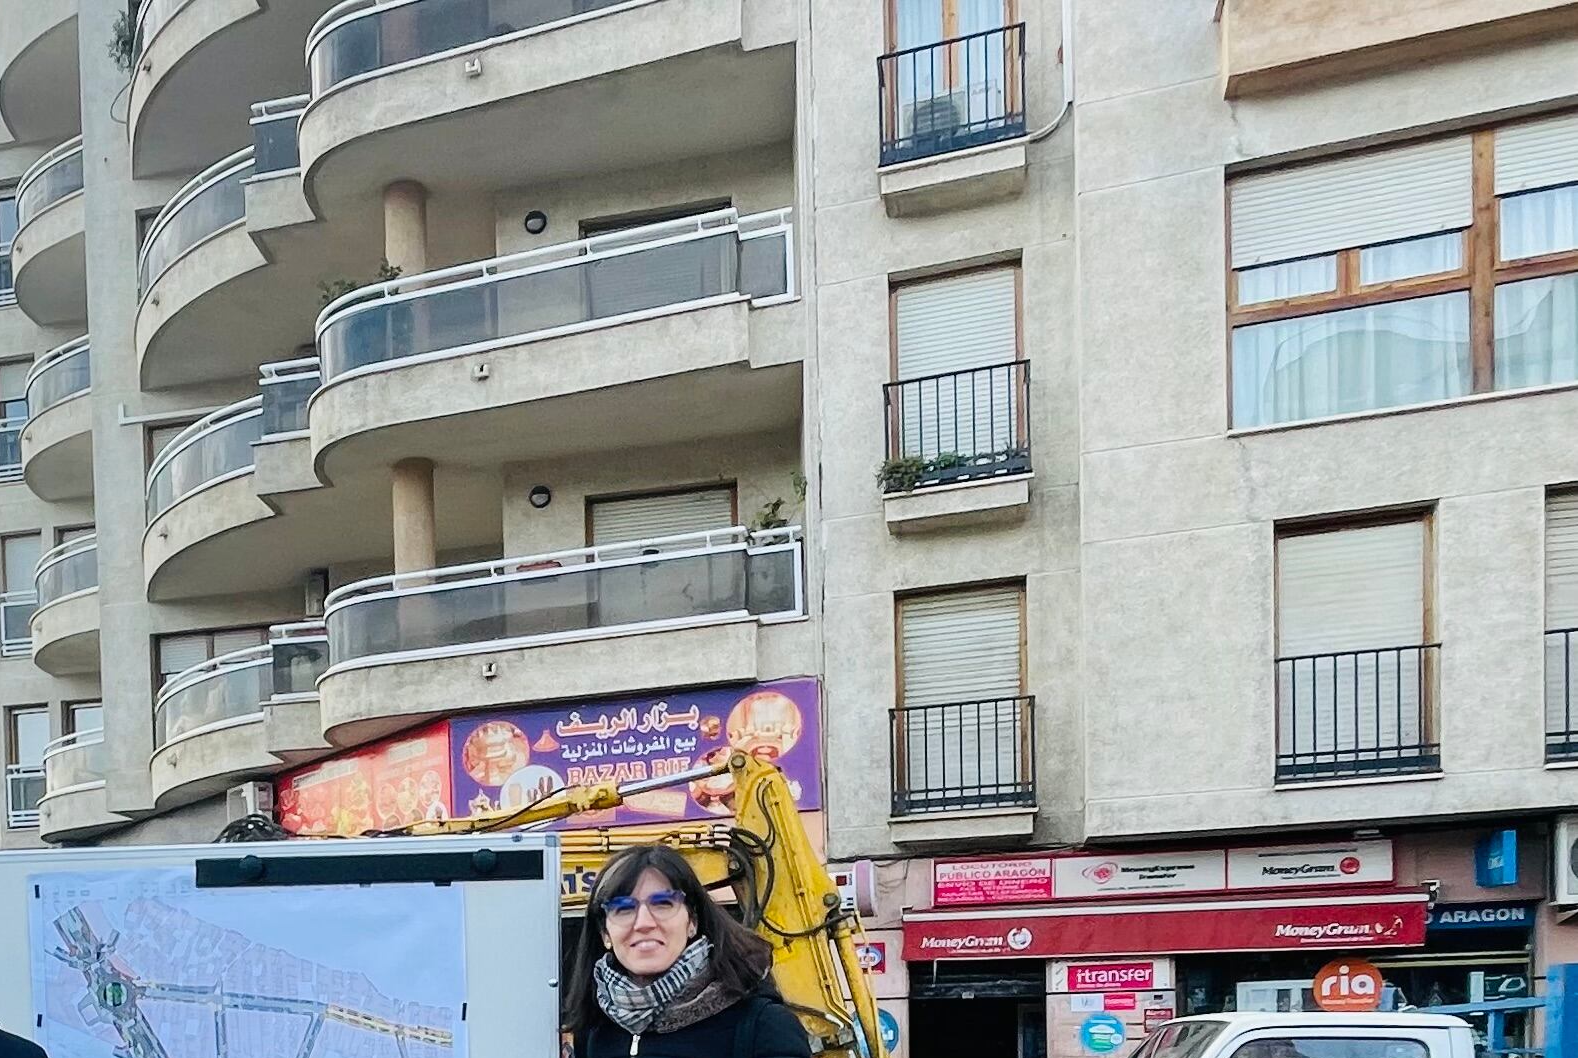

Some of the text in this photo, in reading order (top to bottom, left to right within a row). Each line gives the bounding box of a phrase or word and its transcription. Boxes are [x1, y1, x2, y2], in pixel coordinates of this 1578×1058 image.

[611, 736, 670, 756] المفروشات
[674, 736, 697, 754] بيع
[567, 760, 647, 787] BAZAR
[1439, 907, 1526, 925] ARAGON
[1275, 922, 1372, 938] MoneyGram
[920, 935, 1004, 949] MoneyGram
[1321, 964, 1376, 997] ria
